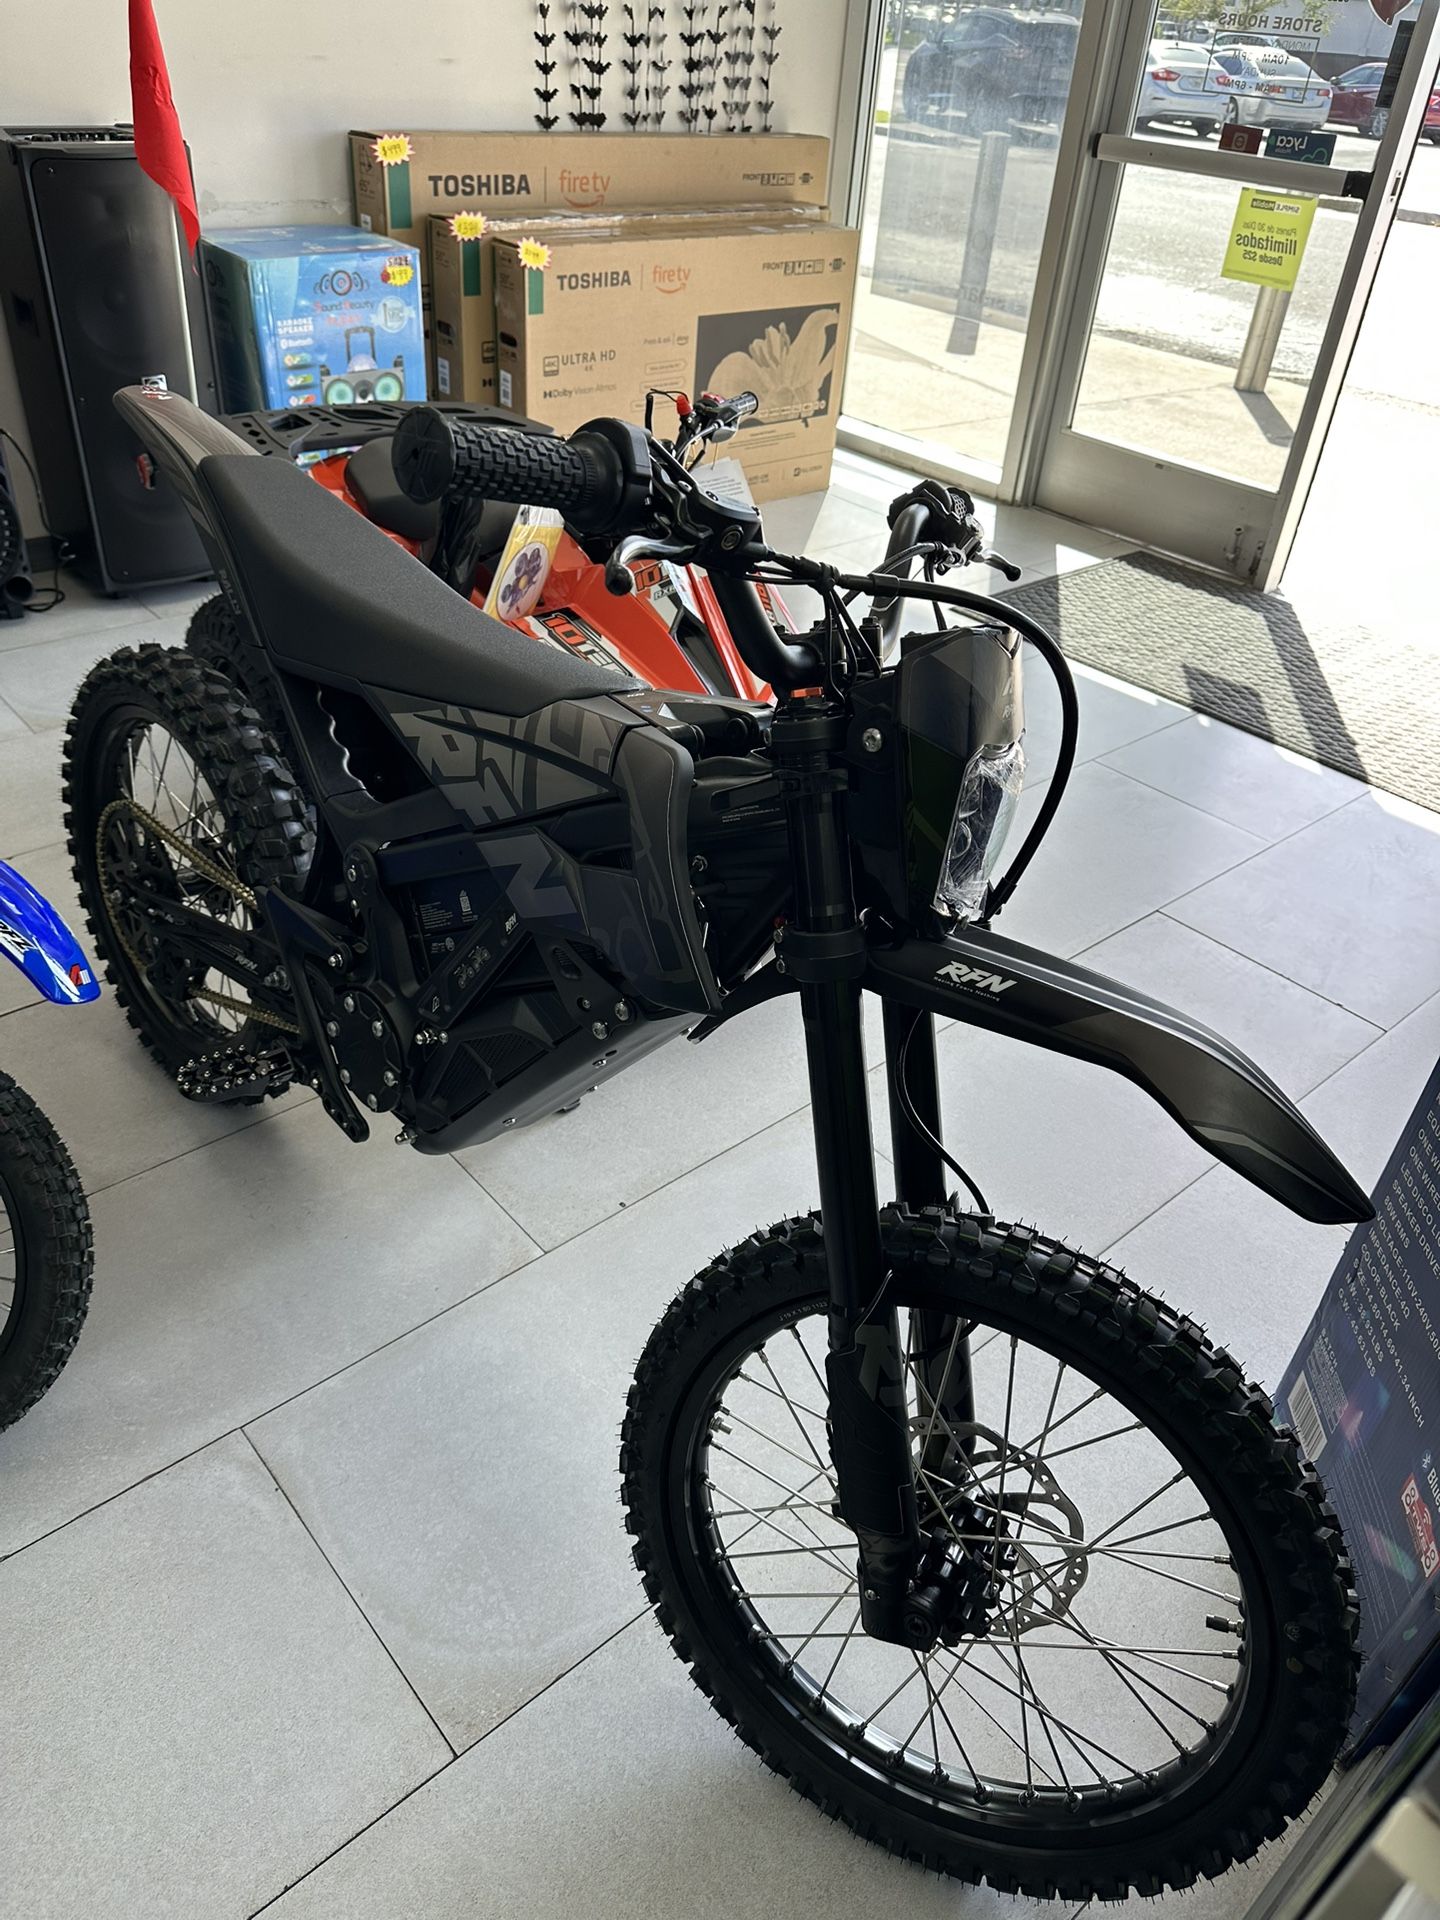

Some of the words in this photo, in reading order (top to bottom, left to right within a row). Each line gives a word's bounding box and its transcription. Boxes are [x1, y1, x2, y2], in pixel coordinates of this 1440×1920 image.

[428, 174, 531, 197] TOSHIBA
[762, 261, 783, 271] FRONT
[557, 270, 631, 292] TOSHIBA
[277, 325, 314, 336] SPEAKER
[561, 352, 597, 366] ULTRA
[600, 350, 616, 361] HD
[552, 386, 573, 399] Dolby
[936, 960, 1018, 993] RFN
[1427, 1110, 1440, 1141] EQU
[1418, 1128, 1433, 1156] ONE
[1409, 1145, 1424, 1174] ONE
[1400, 1161, 1414, 1188] LED
[1411, 1186, 1433, 1226] DISCO
[1384, 1195, 1398, 1221] 80W
[1394, 1219, 1411, 1249] RMS
[1392, 1179, 1421, 1238] SPEAKER
[1361, 1243, 1401, 1332] COLOR:BLACK
[1371, 1334, 1384, 1362] LBS
[1363, 1350, 1376, 1377] LBS
[1407, 1391, 1425, 1428] INCH
